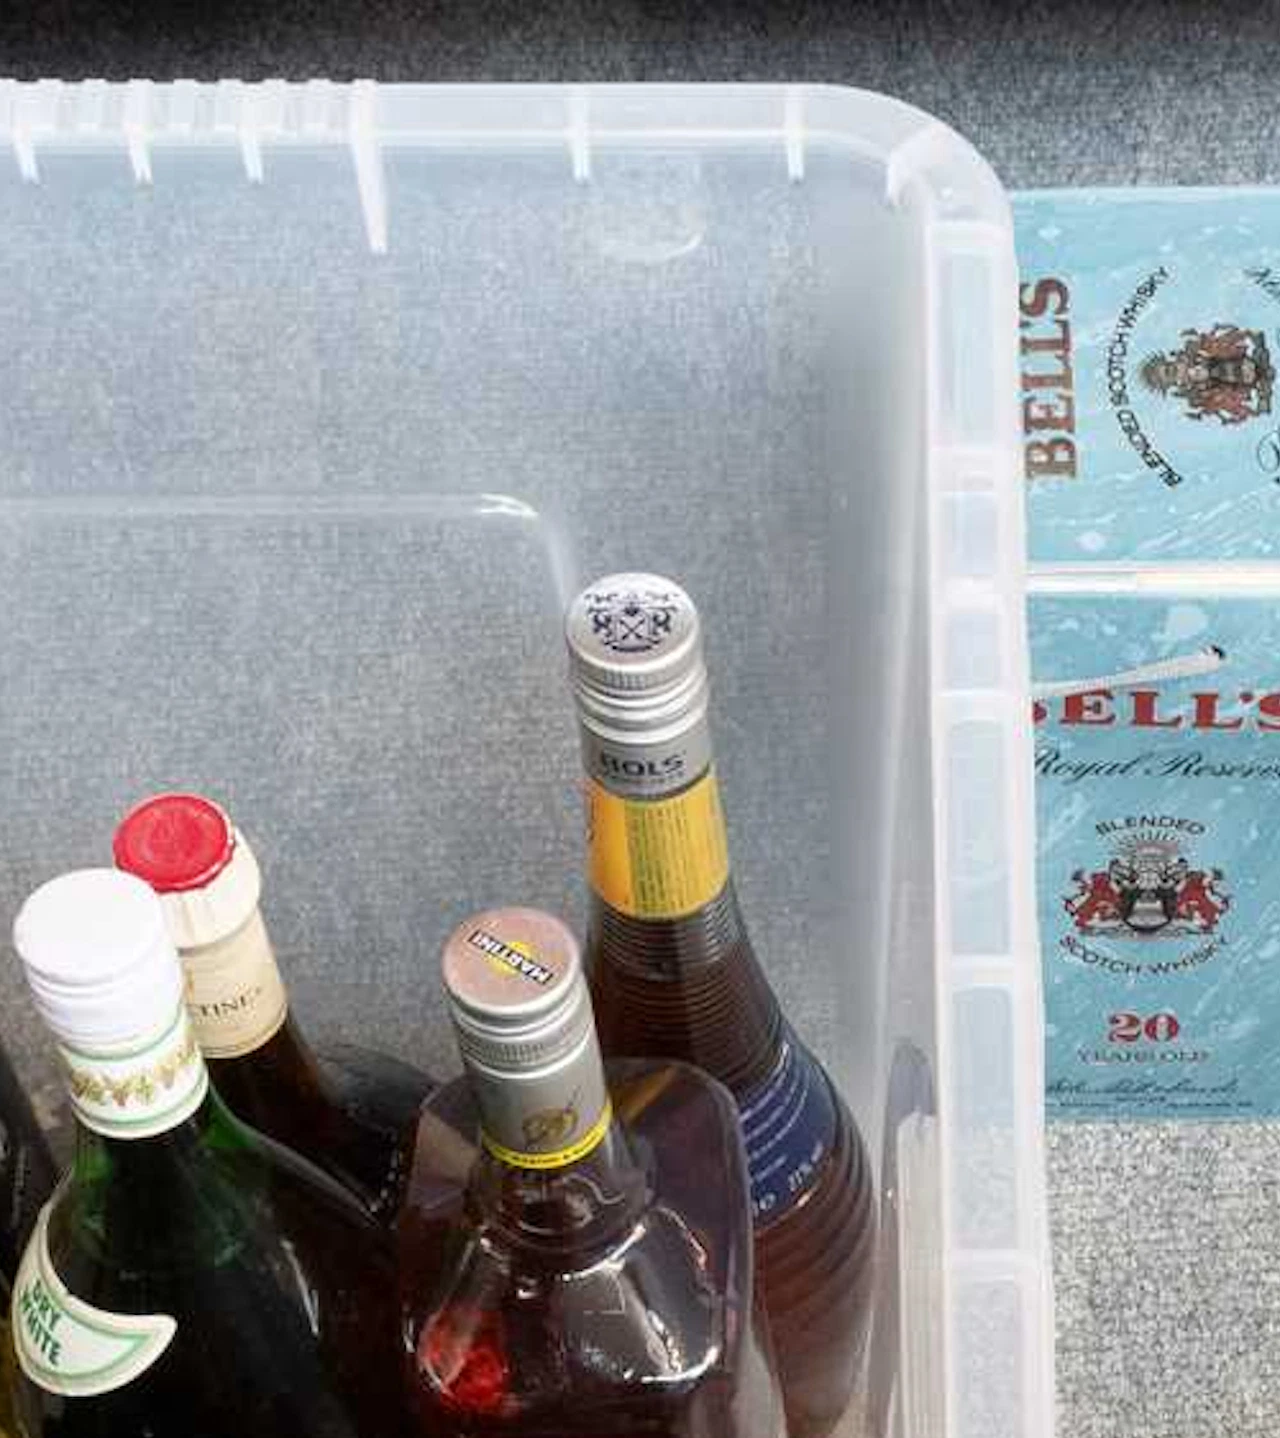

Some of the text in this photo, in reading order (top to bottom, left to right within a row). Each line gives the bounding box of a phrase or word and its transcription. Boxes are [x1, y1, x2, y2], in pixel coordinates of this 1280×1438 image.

[1019, 276, 1078, 480] BELL'S
[1107, 266, 1184, 489] BLENDED SCOTCH WHISKY
[600, 753, 684, 777] BOLS
[1034, 748, 1145, 781] Royal
[1095, 815, 1206, 837] BLENDED
[475, 933, 551, 984] MARTINI
[1060, 935, 1144, 976] SCOTCH
[1106, 1010, 1181, 1045] 20
[32, 1280, 61, 1331] DRY
